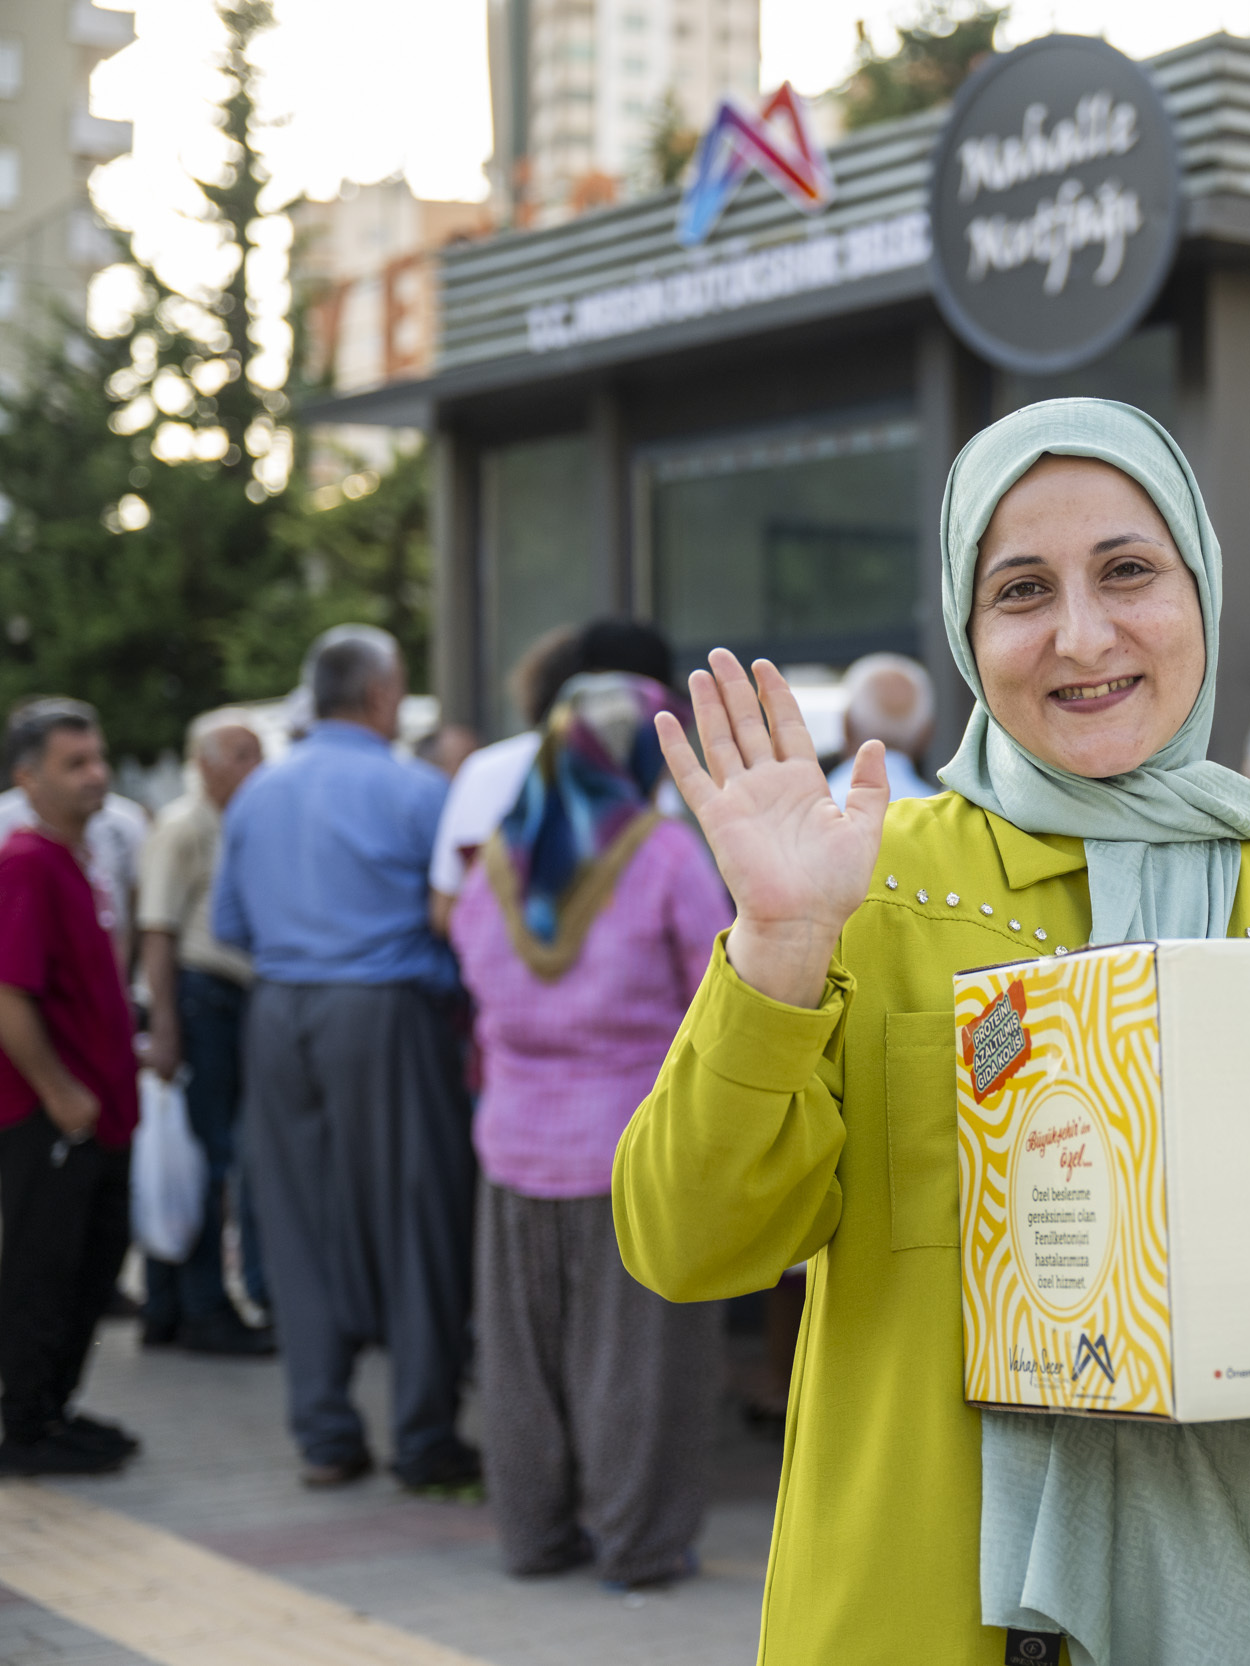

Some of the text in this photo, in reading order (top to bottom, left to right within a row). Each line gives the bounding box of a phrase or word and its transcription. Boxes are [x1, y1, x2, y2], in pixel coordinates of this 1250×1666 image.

[974, 995, 1011, 1048] PROTEİNİ
[974, 1013, 1019, 1071] AZALTILMIŞ
[976, 1029, 1025, 1089] GIDA KOLİSİ
[1032, 1185, 1091, 1201] Özel beslenme
[1027, 1208, 1097, 1227] gereksinimi olan
[1037, 1274, 1054, 1289] özel
